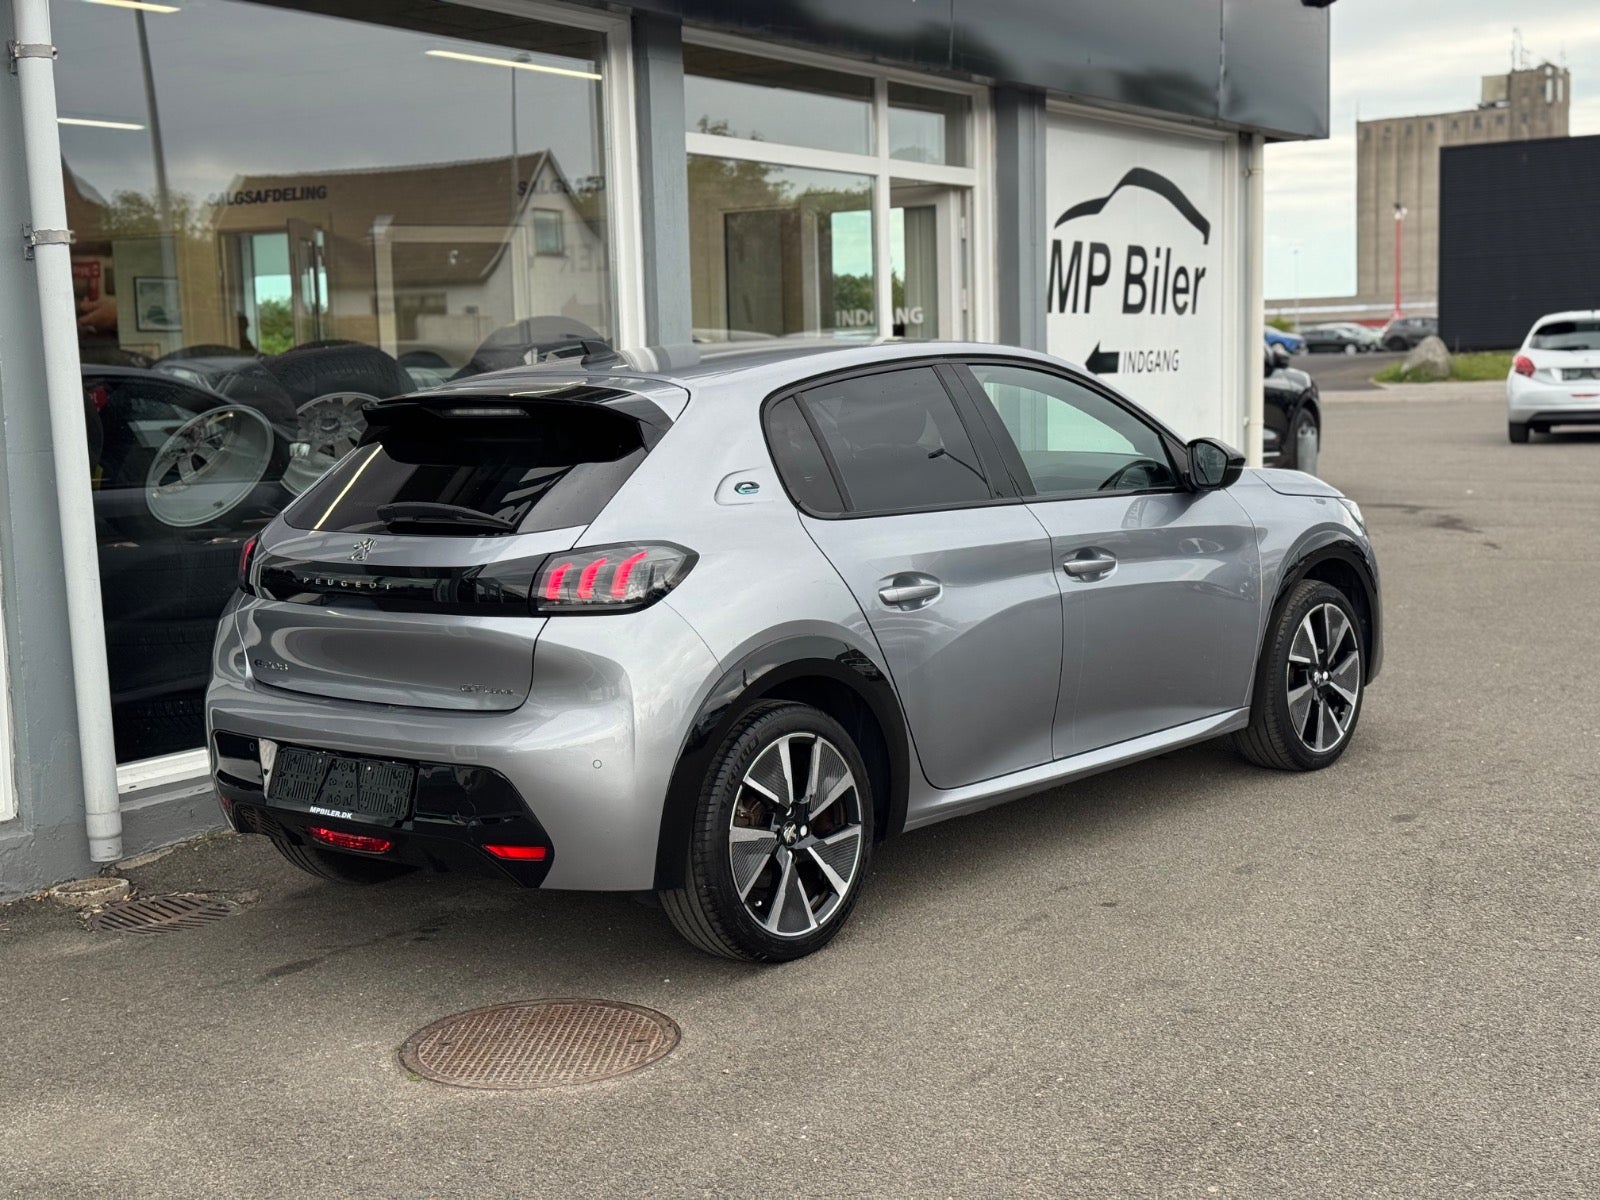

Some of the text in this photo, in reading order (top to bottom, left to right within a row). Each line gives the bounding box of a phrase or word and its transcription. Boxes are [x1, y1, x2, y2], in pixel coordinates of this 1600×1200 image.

[1047, 239, 1206, 315] MP Biler
[835, 306, 924, 327] INDNG
[1122, 349, 1179, 374] INDGANG
[303, 577, 392, 590] PEUGEOT
[309, 805, 352, 820] MPBILER.DK
